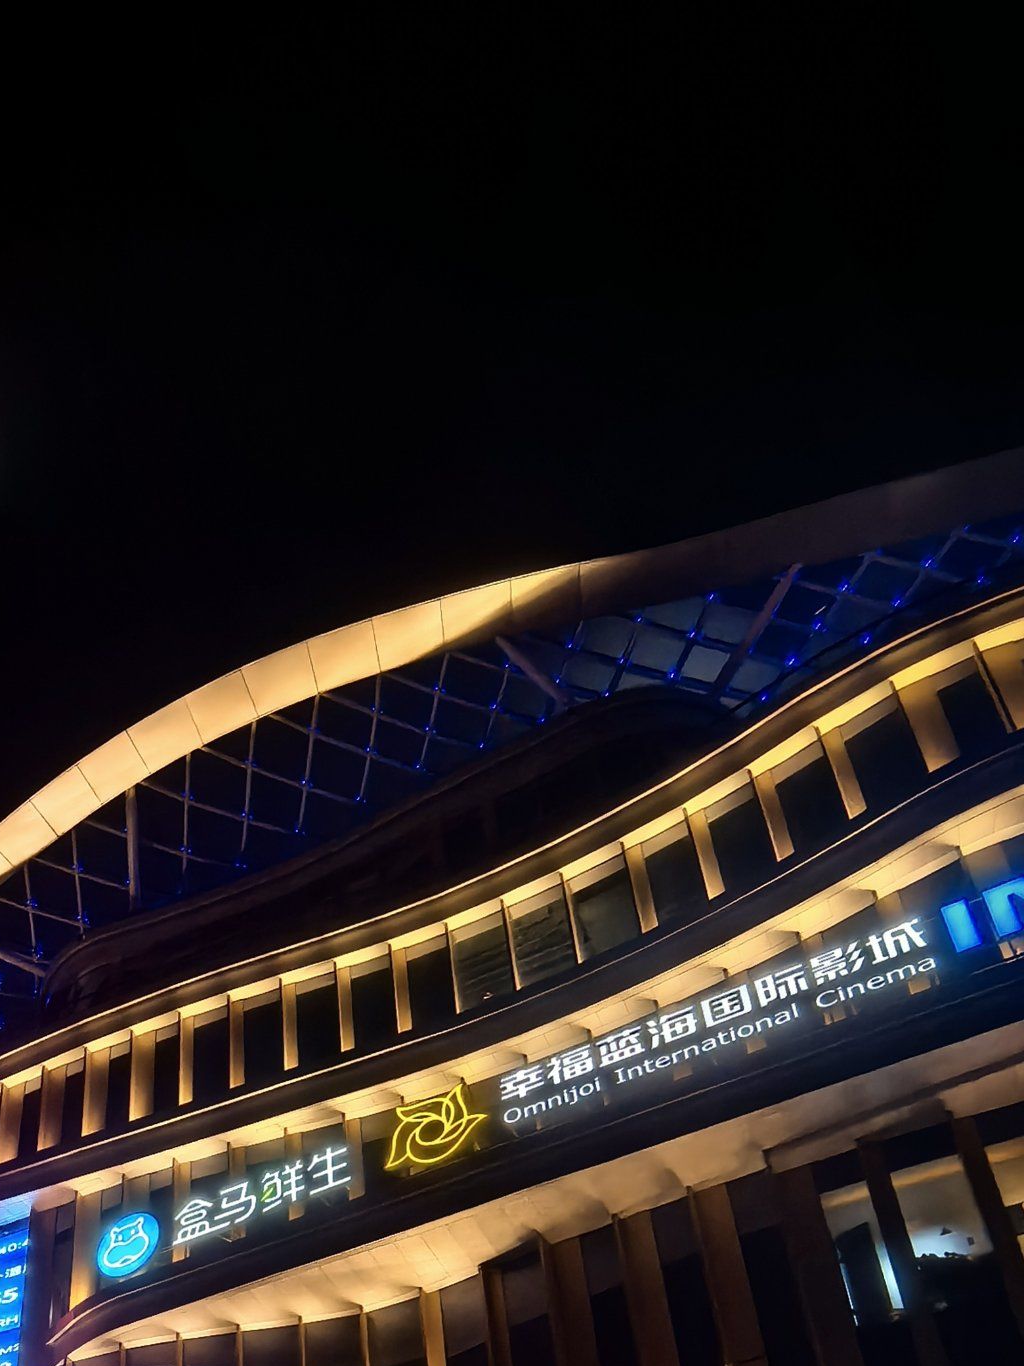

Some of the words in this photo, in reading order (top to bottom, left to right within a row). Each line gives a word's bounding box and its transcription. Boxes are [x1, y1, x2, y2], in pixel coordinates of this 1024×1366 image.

[499, 918, 928, 1102] 幸福蓝海国际影城
[503, 1077, 602, 1124] Omnijoi
[615, 1003, 800, 1085] International
[815, 957, 937, 1009] Cinema
[172, 1147, 352, 1246] 盒马鲜生
